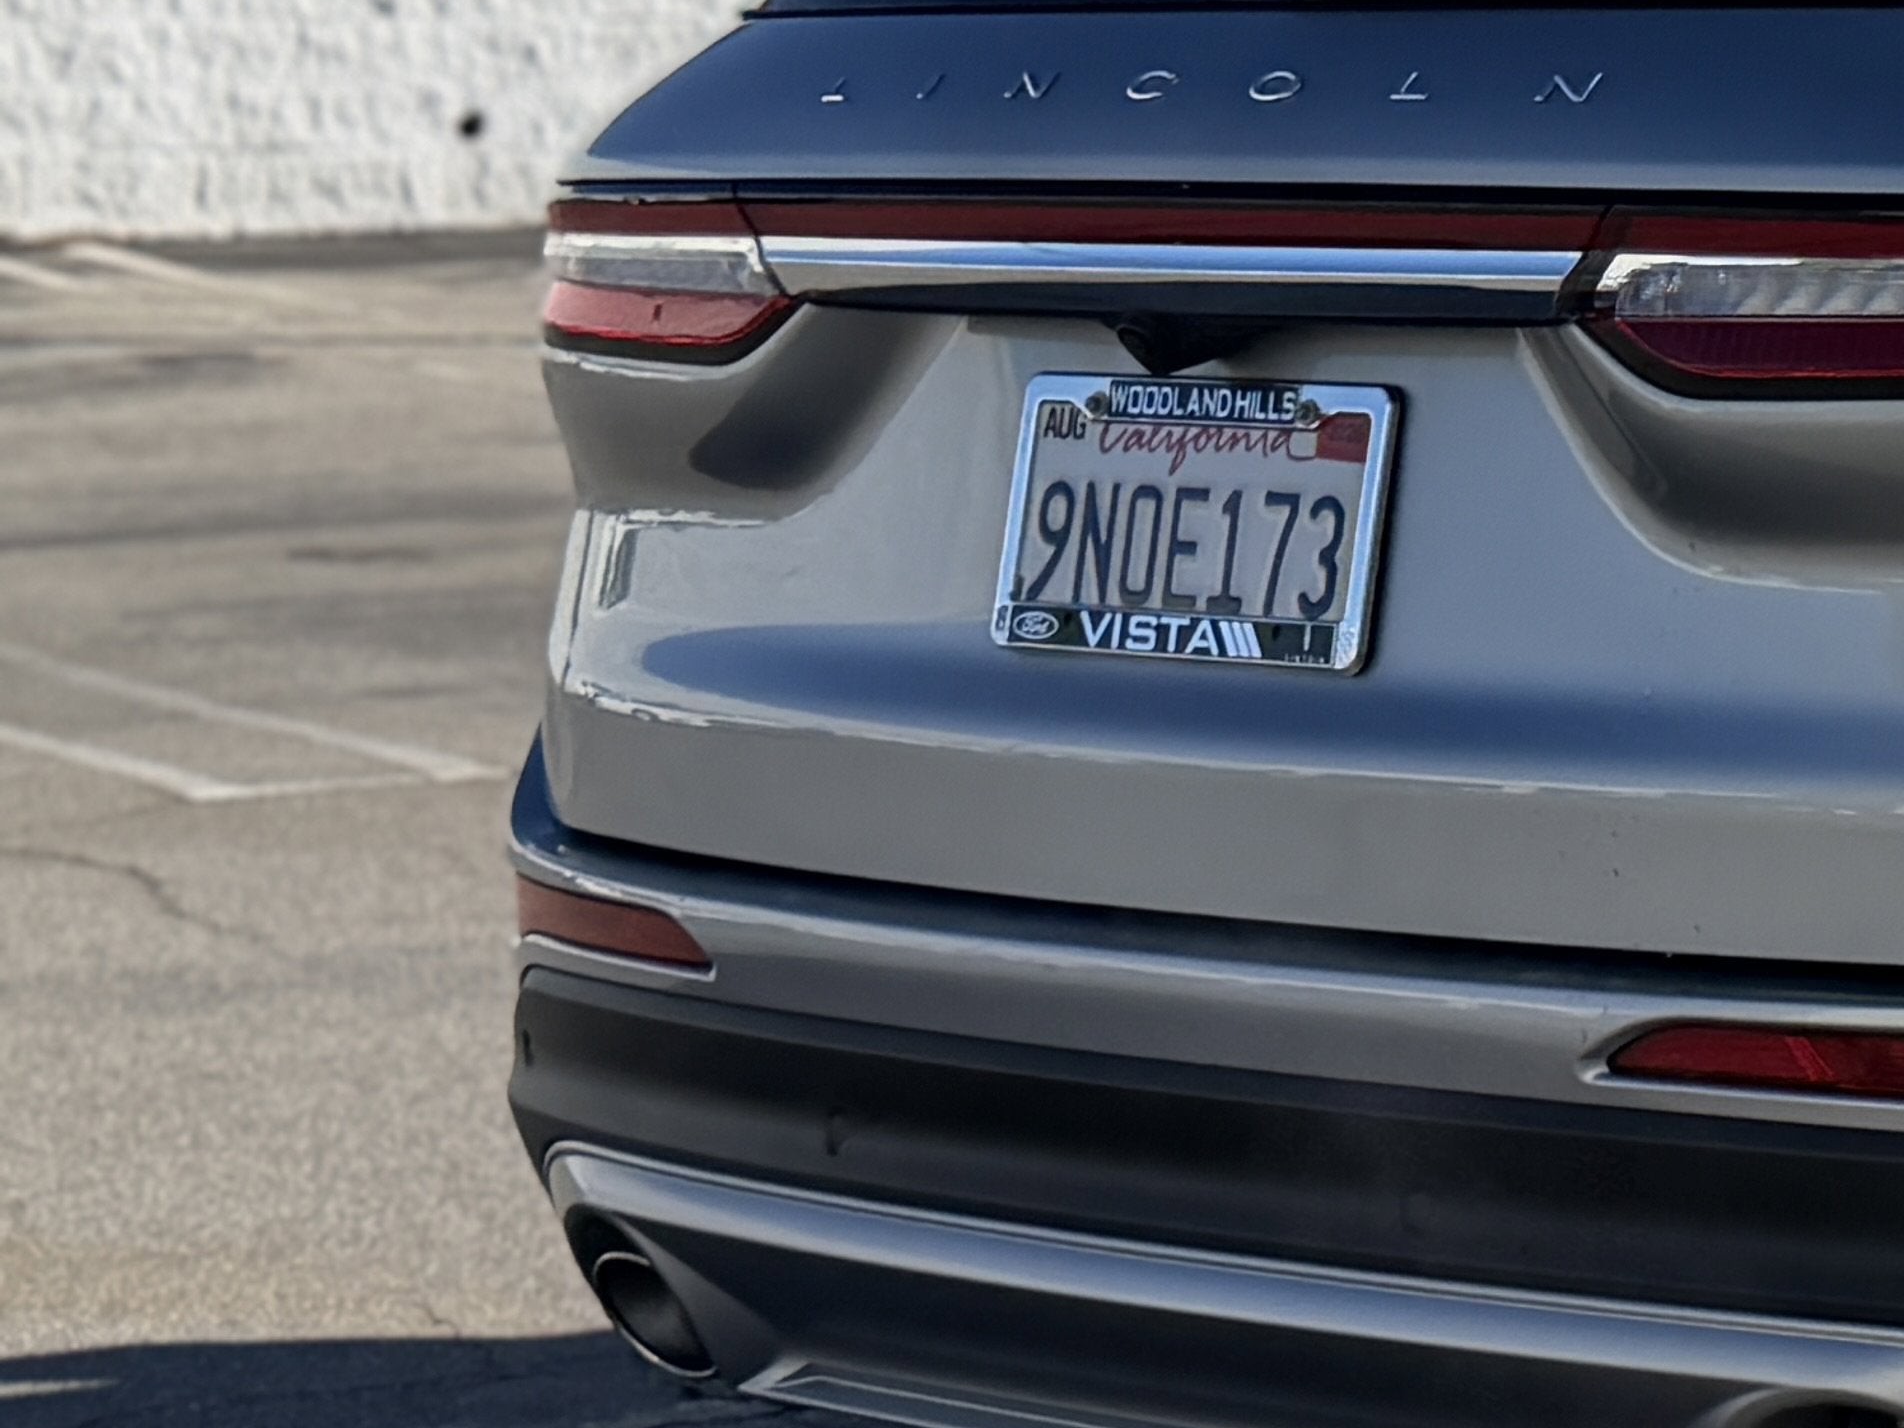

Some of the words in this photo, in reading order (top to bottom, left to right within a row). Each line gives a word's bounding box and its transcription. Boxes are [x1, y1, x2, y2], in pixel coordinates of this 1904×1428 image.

[820, 70, 1604, 103] LINCOLN
[1111, 385, 1230, 418] WOODLAND
[1235, 389, 1296, 420] HILLS
[1043, 406, 1087, 440] AUG
[1025, 479, 1346, 621] 9NOE173
[1080, 610, 1220, 656] VISTA
